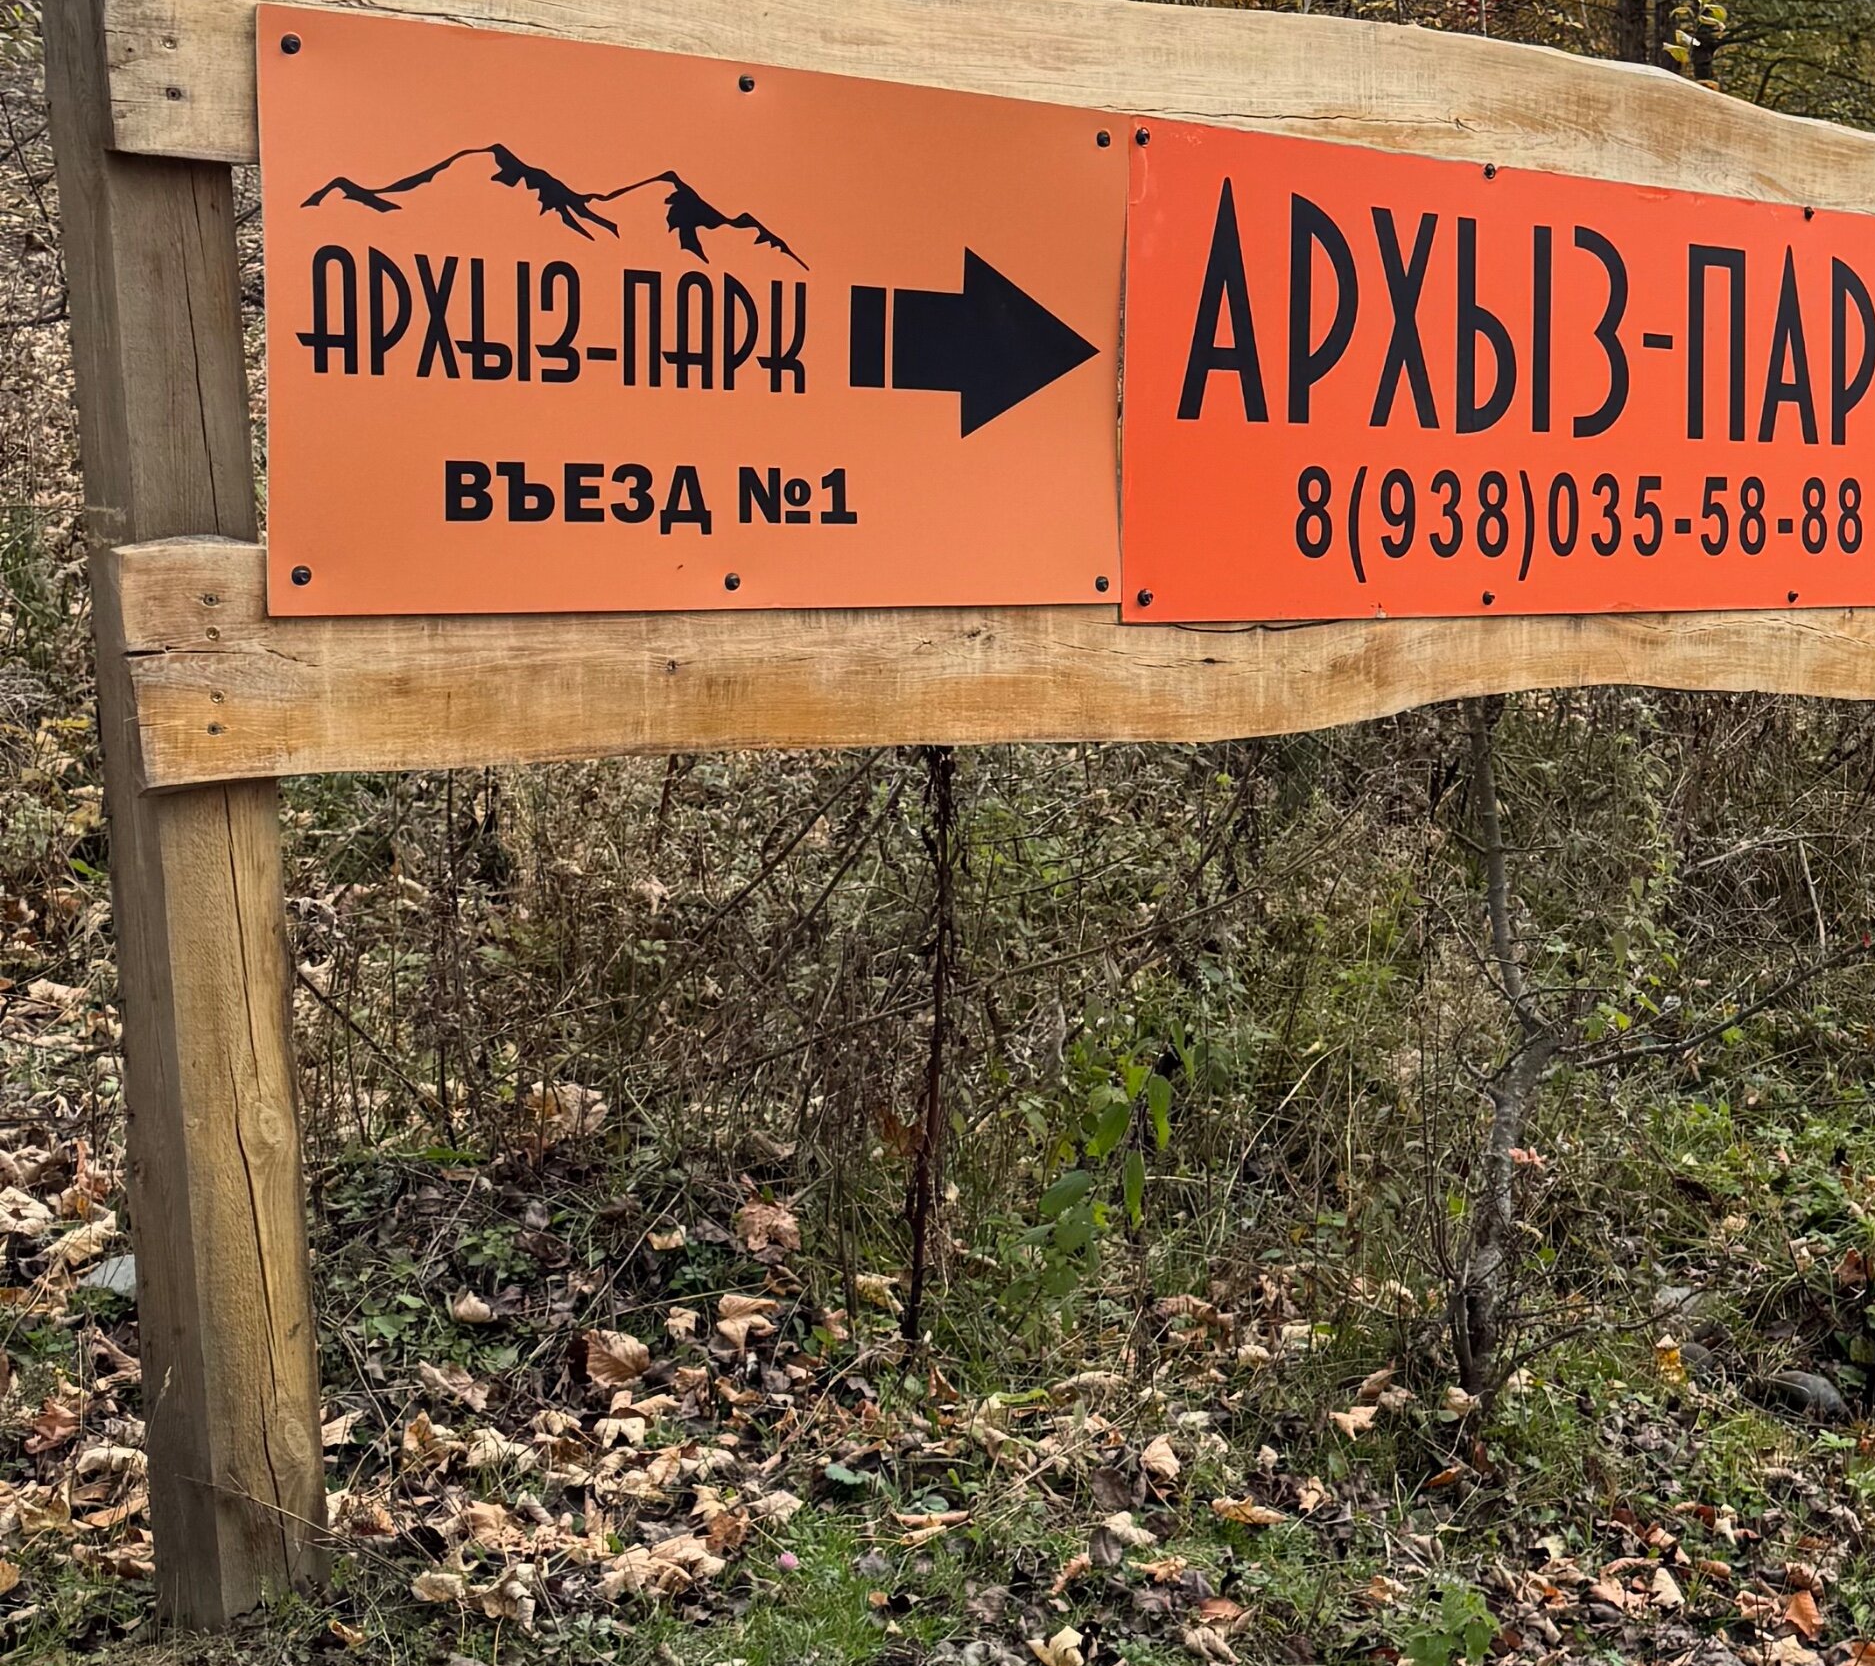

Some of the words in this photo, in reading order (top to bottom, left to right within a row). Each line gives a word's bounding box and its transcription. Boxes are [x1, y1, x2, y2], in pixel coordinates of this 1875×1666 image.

[296, 244, 807, 395] АРХЫЗ-ПАРК
[444, 460, 712, 536] ВЪЕЗД
[738, 466, 858, 525] №1
[1295, 465, 1863, 584] 8(938)035-58-88
